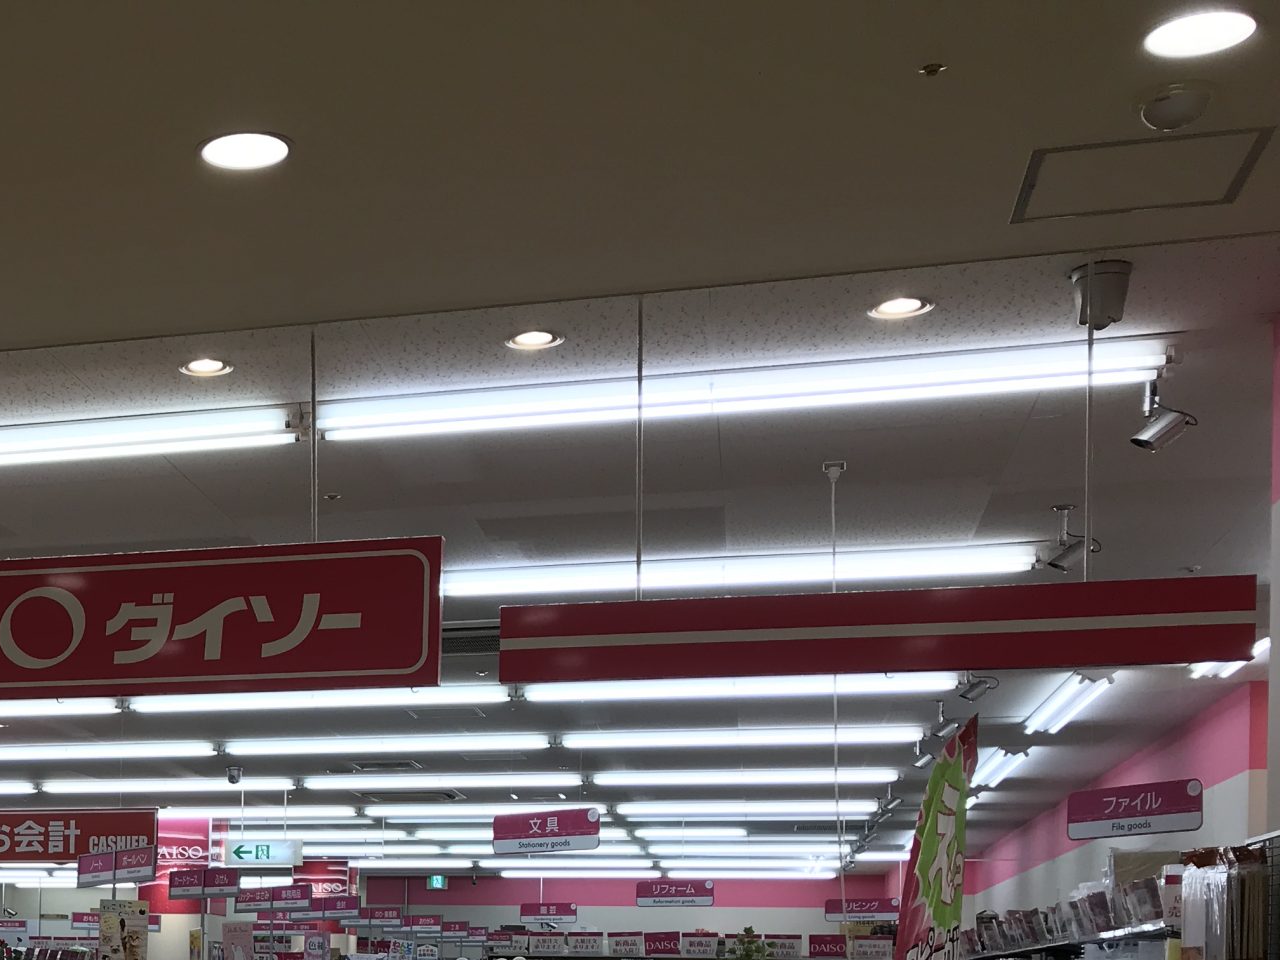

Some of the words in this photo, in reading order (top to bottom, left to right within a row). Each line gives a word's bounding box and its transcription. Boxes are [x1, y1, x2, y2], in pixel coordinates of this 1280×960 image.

[106, 592, 361, 664] ダイソー
[1102, 792, 1161, 814] ファイル
[529, 816, 559, 833] 文具
[1112, 822, 1125, 831] File
[1127, 820, 1151, 832] goods
[89, 836, 147, 852] CASHIER
[518, 841, 549, 849] Stationery
[551, 840, 570, 849] goods
[157, 846, 203, 859] AISO
[89, 859, 103, 871] ノート
[311, 883, 342, 892] AISO
[652, 884, 695, 894] リフォーム
[646, 941, 679, 950] DAISO
[811, 944, 845, 952] DAISO
